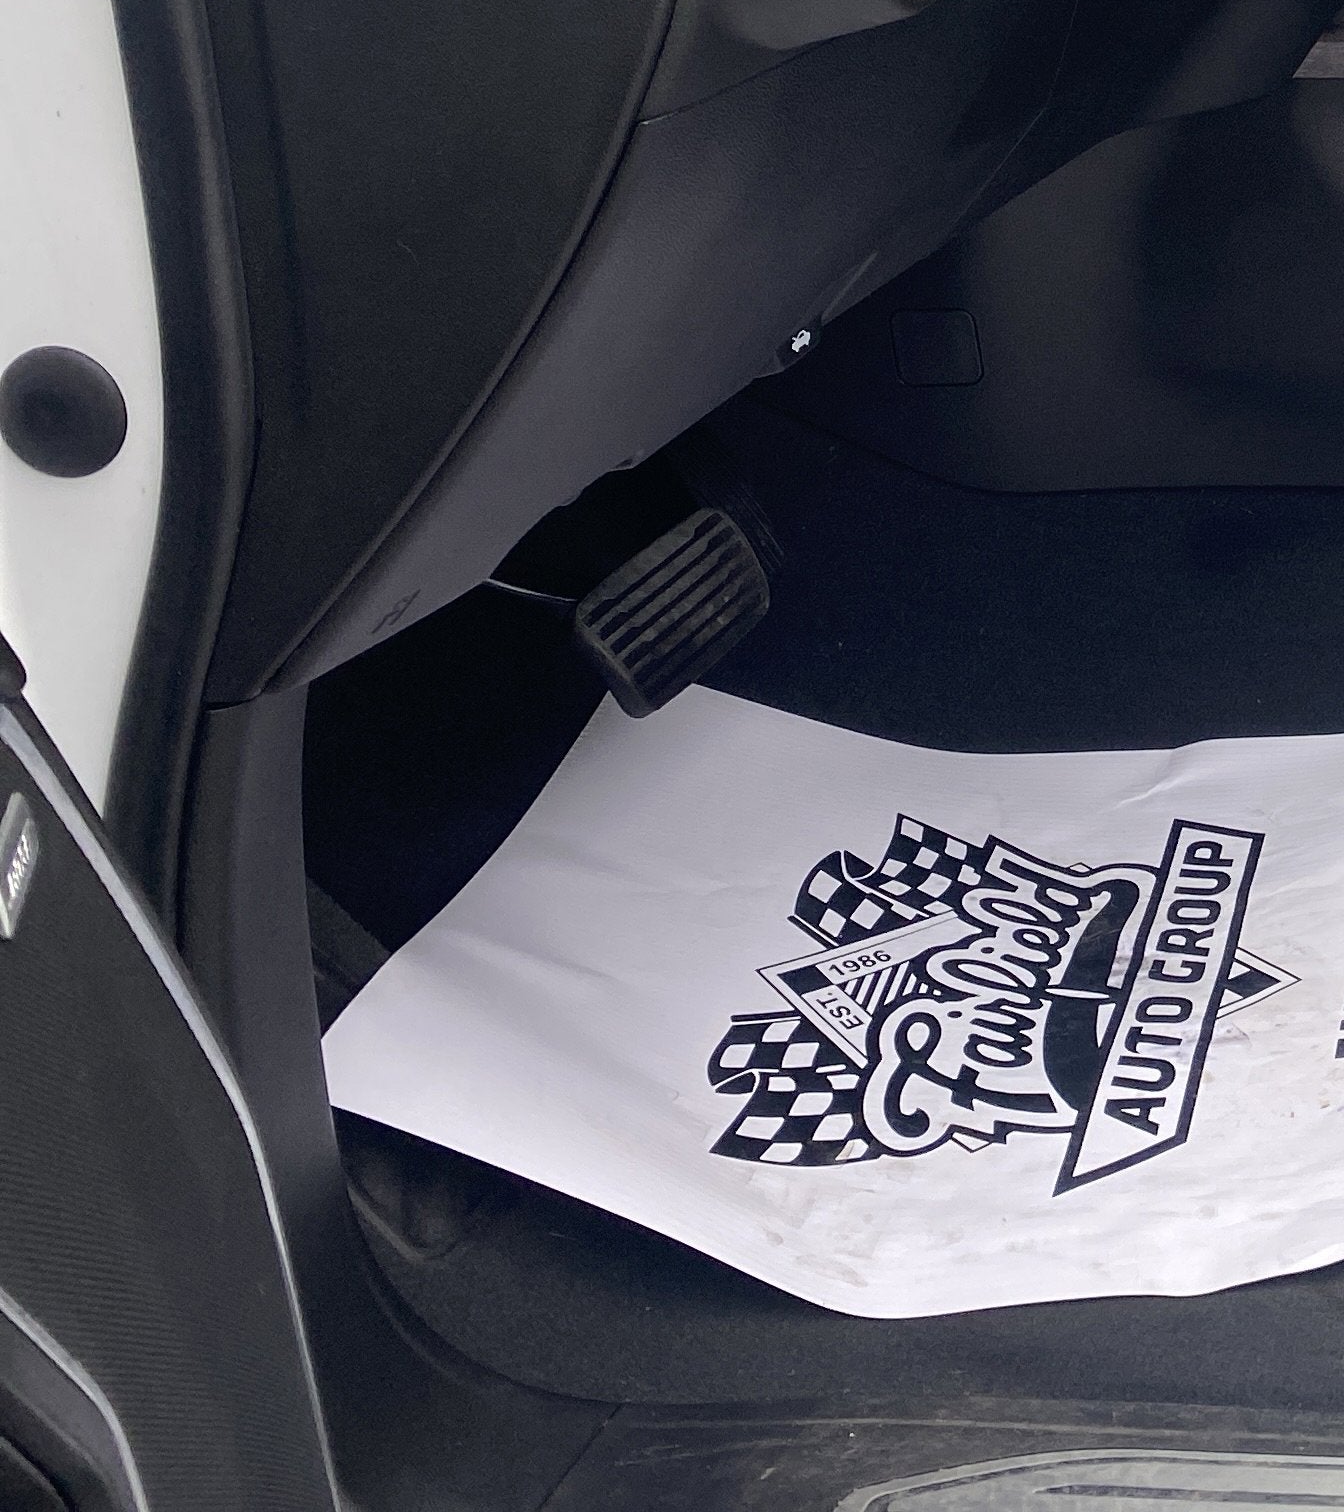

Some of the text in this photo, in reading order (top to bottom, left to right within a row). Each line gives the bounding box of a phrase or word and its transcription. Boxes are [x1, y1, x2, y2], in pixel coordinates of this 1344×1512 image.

[816, 992, 864, 1029] EST.
[828, 950, 891, 976] 1986
[884, 857, 1112, 1138] Fairfield
[1104, 840, 1234, 1136] AUTO GROUP
